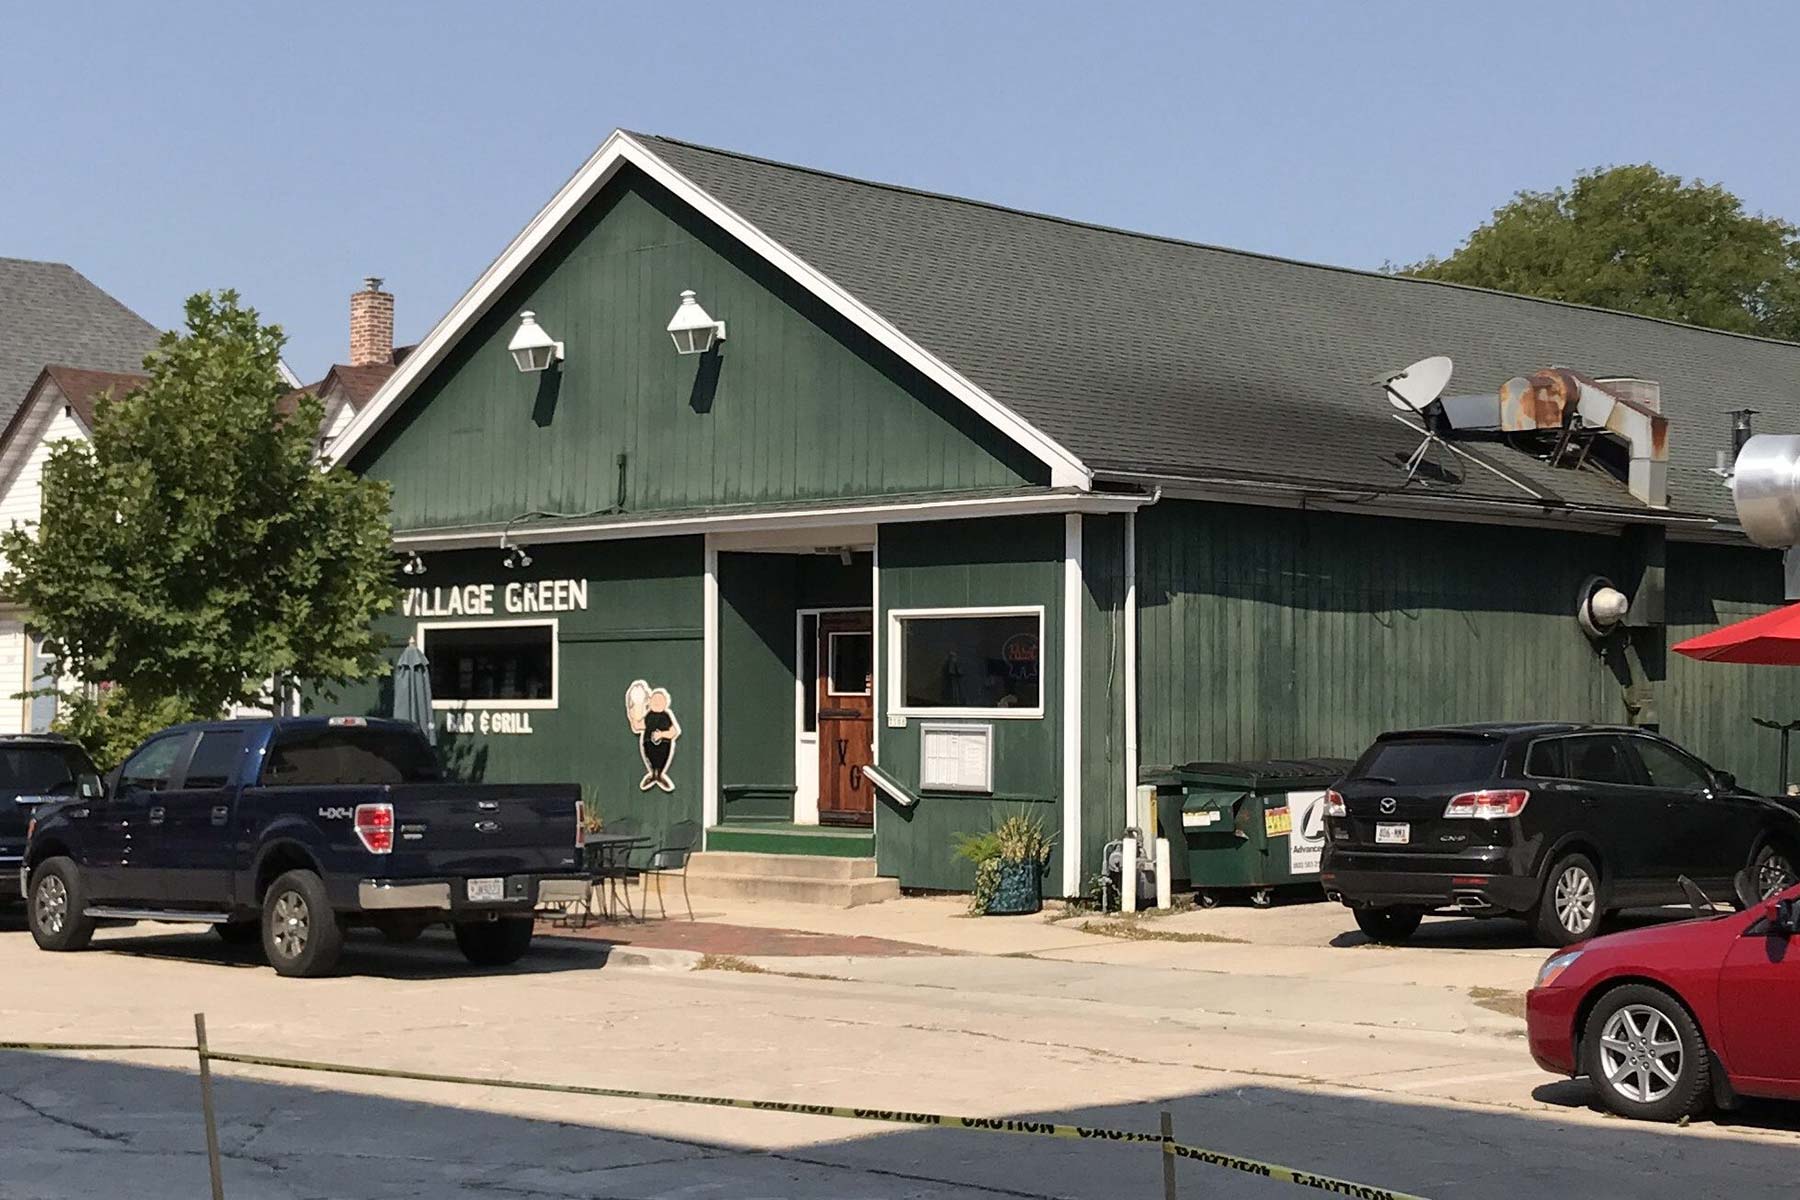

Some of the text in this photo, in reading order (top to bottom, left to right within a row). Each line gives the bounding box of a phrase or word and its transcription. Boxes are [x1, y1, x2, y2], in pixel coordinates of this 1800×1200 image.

[402, 578, 587, 616] VILLAGE GREEN
[446, 711, 474, 733] BAR
[492, 712, 533, 734] GRILL
[853, 1108, 940, 1124] CAUTION
[961, 1117, 1055, 1134] CAUTION
